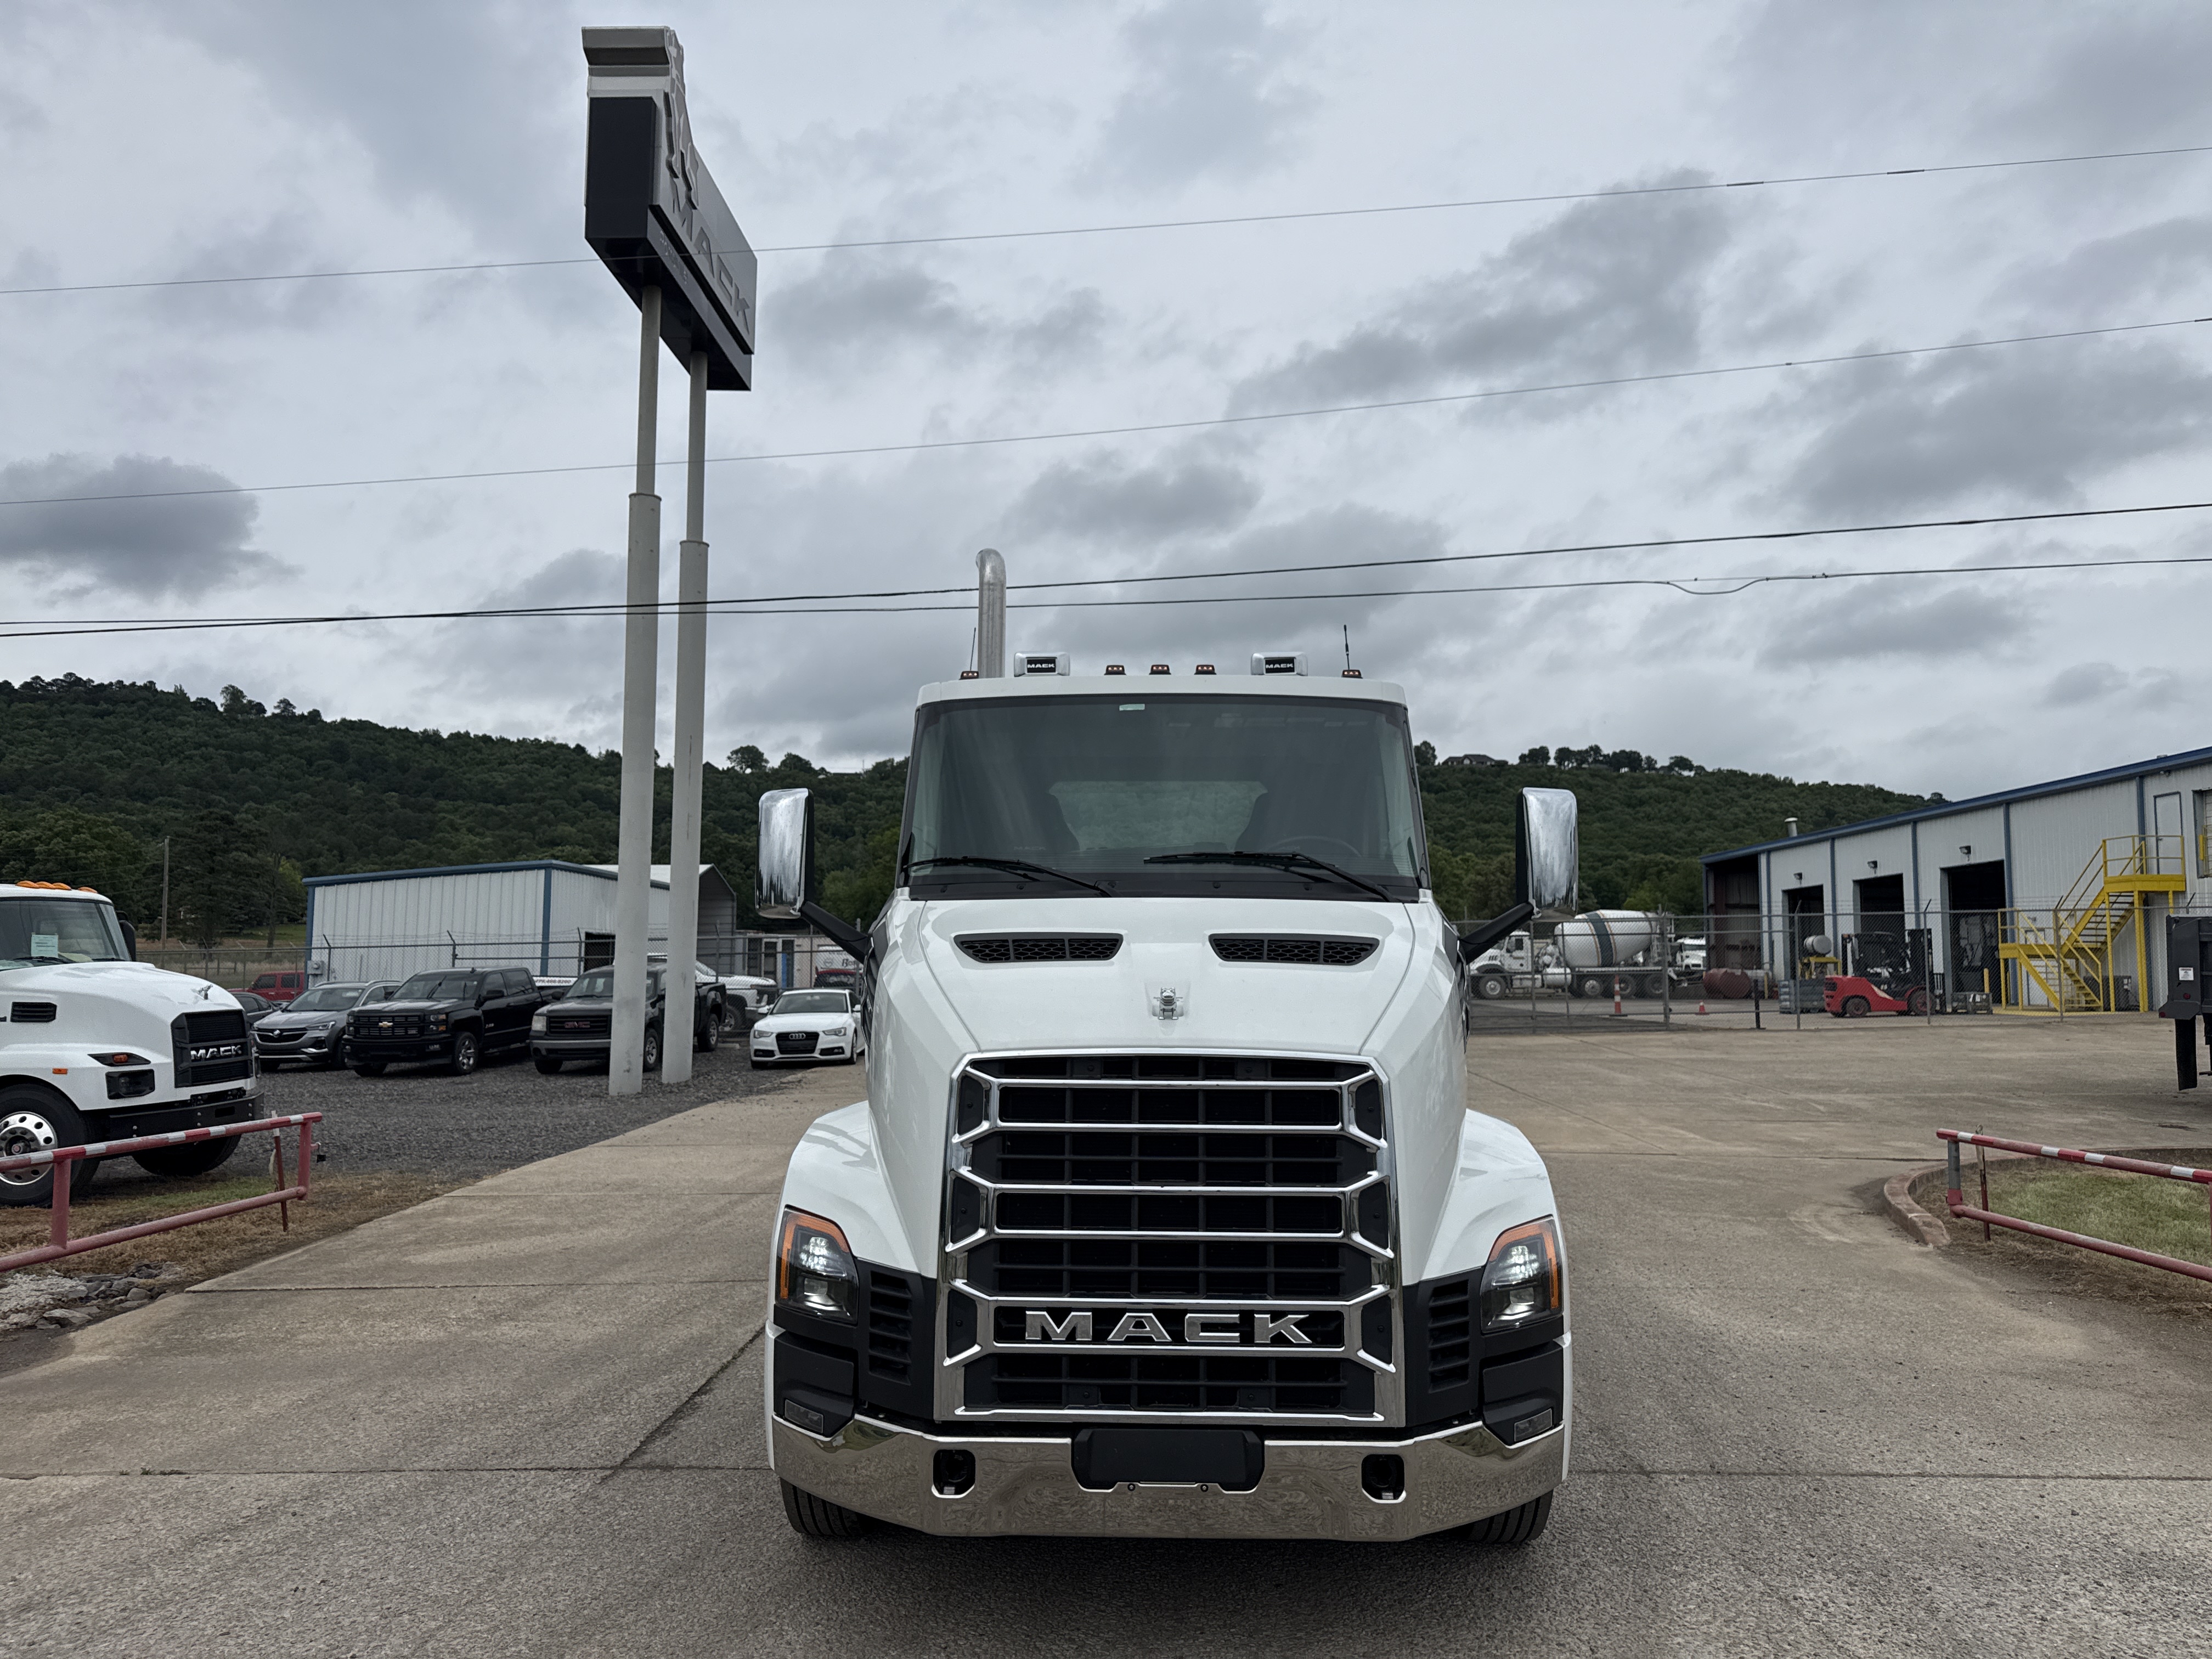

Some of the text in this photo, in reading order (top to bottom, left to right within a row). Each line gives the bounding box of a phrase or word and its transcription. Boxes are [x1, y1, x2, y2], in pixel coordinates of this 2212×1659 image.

[670, 176, 751, 335] MACK
[190, 1045, 242, 1060] MACK
[1025, 1311, 1313, 1344] MACK
